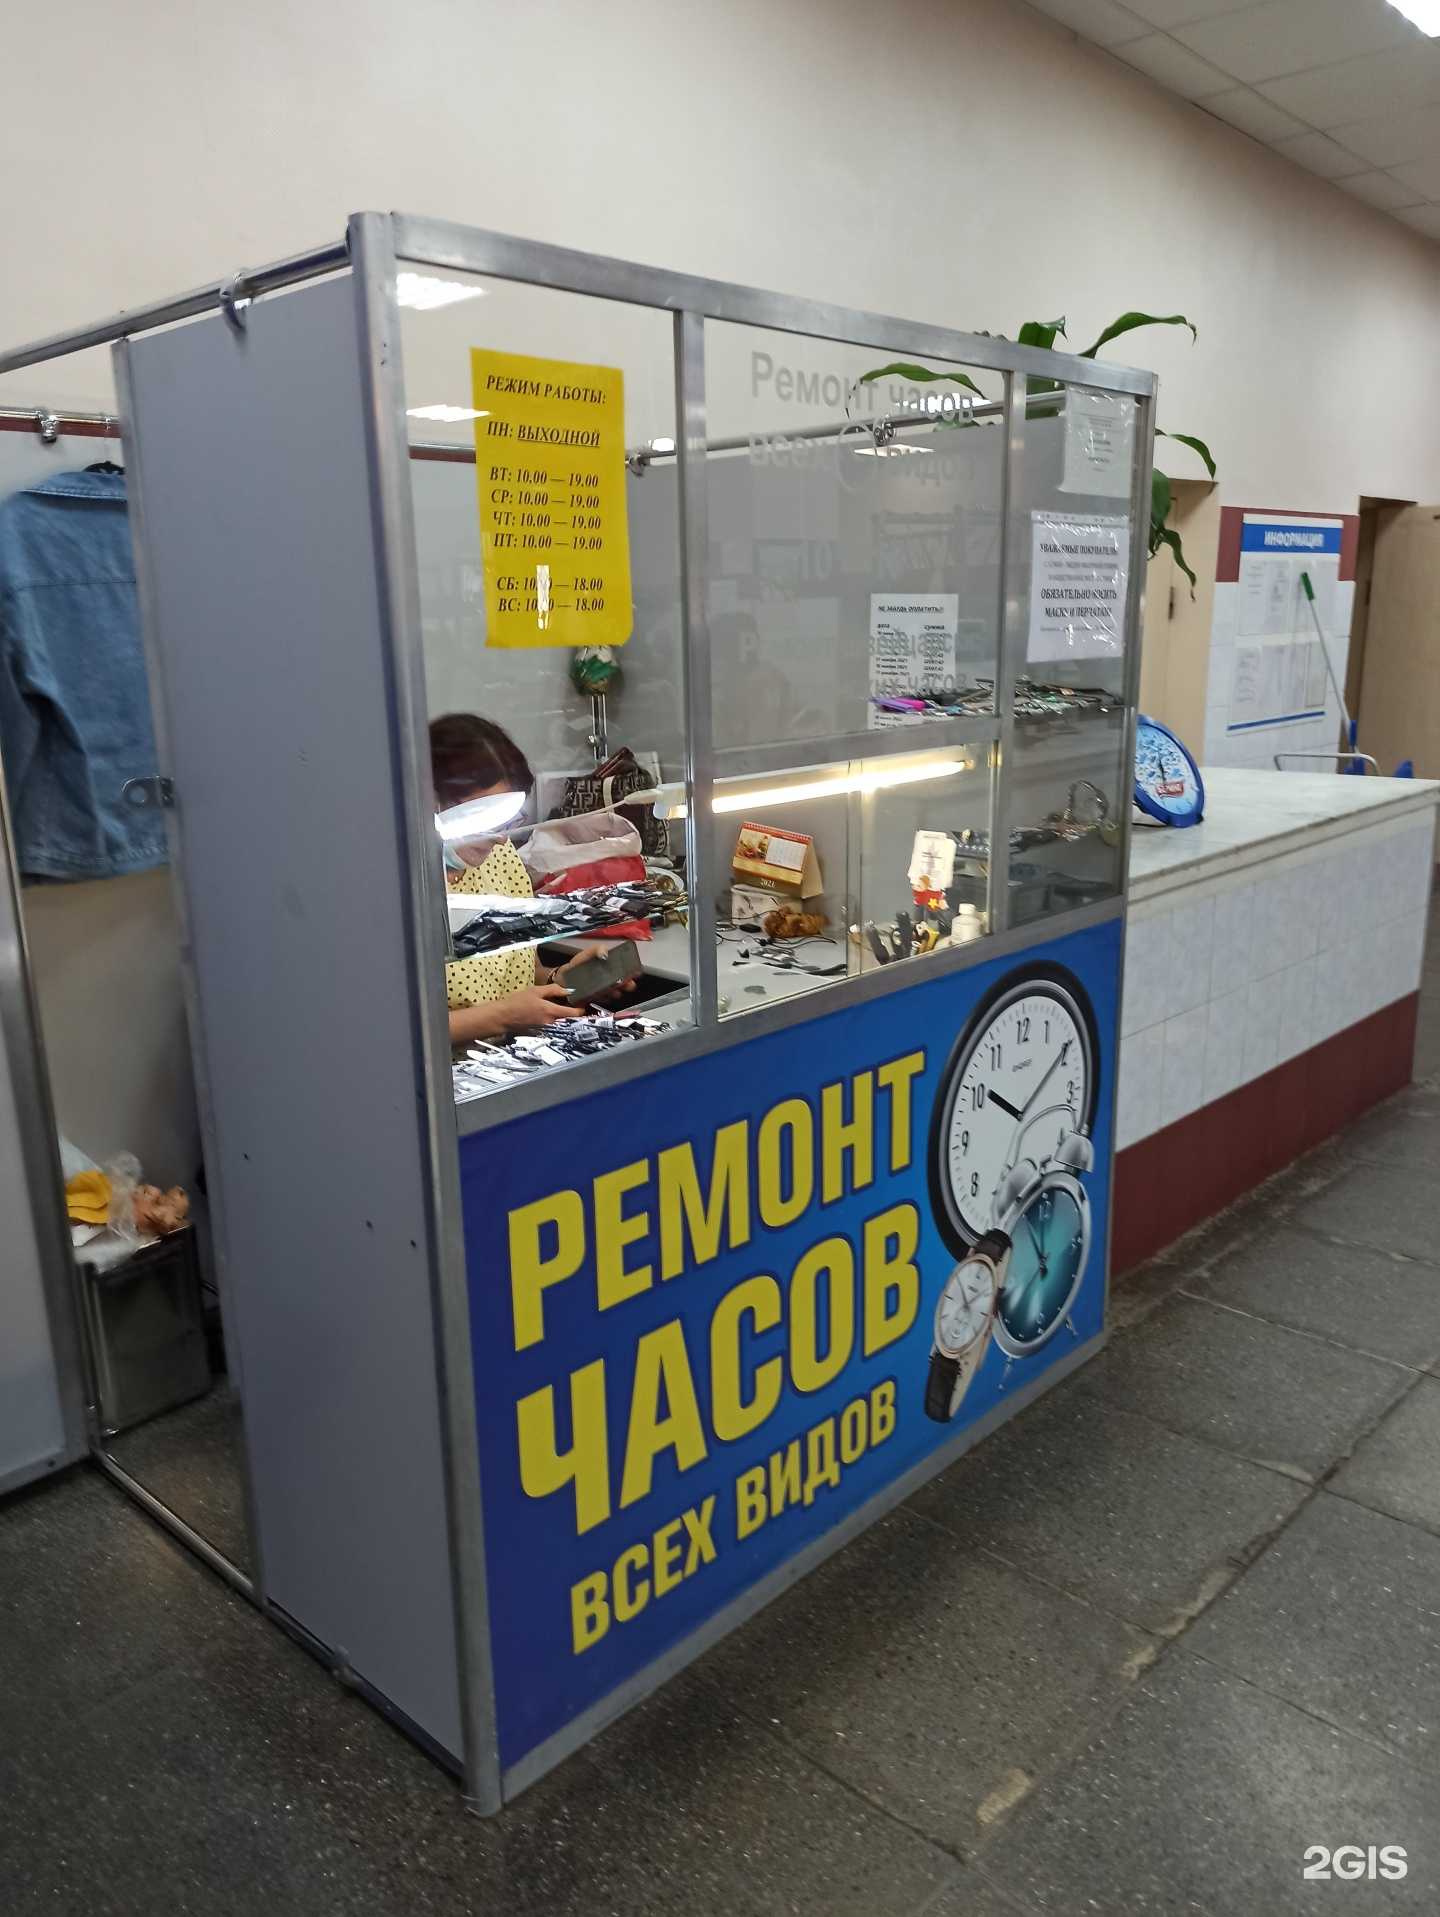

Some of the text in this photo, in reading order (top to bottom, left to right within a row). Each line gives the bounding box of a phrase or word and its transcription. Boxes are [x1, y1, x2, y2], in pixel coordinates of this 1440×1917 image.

[486, 375, 606, 404] РЕЖИМ РАБОТЫ:
[751, 352, 879, 411] Ремонт
[487, 421, 600, 447] ПН: ВЫХОДНОЙ
[490, 466, 512, 481] ВТ:
[517, 468, 547, 484] 10.00
[569, 472, 599, 487] 19.00
[491, 488, 513, 504] СР:
[518, 490, 549, 505] 10.00
[570, 494, 600, 508] 19.00
[493, 511, 516, 526] ЧТ:
[520, 512, 551, 527] 10.00
[572, 515, 601, 529] 19.00
[494, 532, 518, 548] ПТ:
[522, 534, 552, 549] 10.00
[573, 537, 602, 551] 19.00
[497, 576, 519, 591] СБ:
[574, 577, 603, 591] 18.00
[499, 598, 521, 612] ВС:
[576, 598, 604, 612] 18.00
[1017, 1017, 1030, 1045] 12
[991, 1044, 1001, 1072] 11
[972, 1083, 985, 1112] 10
[1067, 1080, 1074, 1104] 3
[962, 1131, 969, 1156] 9
[971, 1172, 978, 1198] 8
[508, 1051, 925, 1352] РЕМОНТ
[516, 1203, 920, 1536] ЧАСОВ
[570, 1380, 896, 1655] ВСЕХ ВИДОВ
